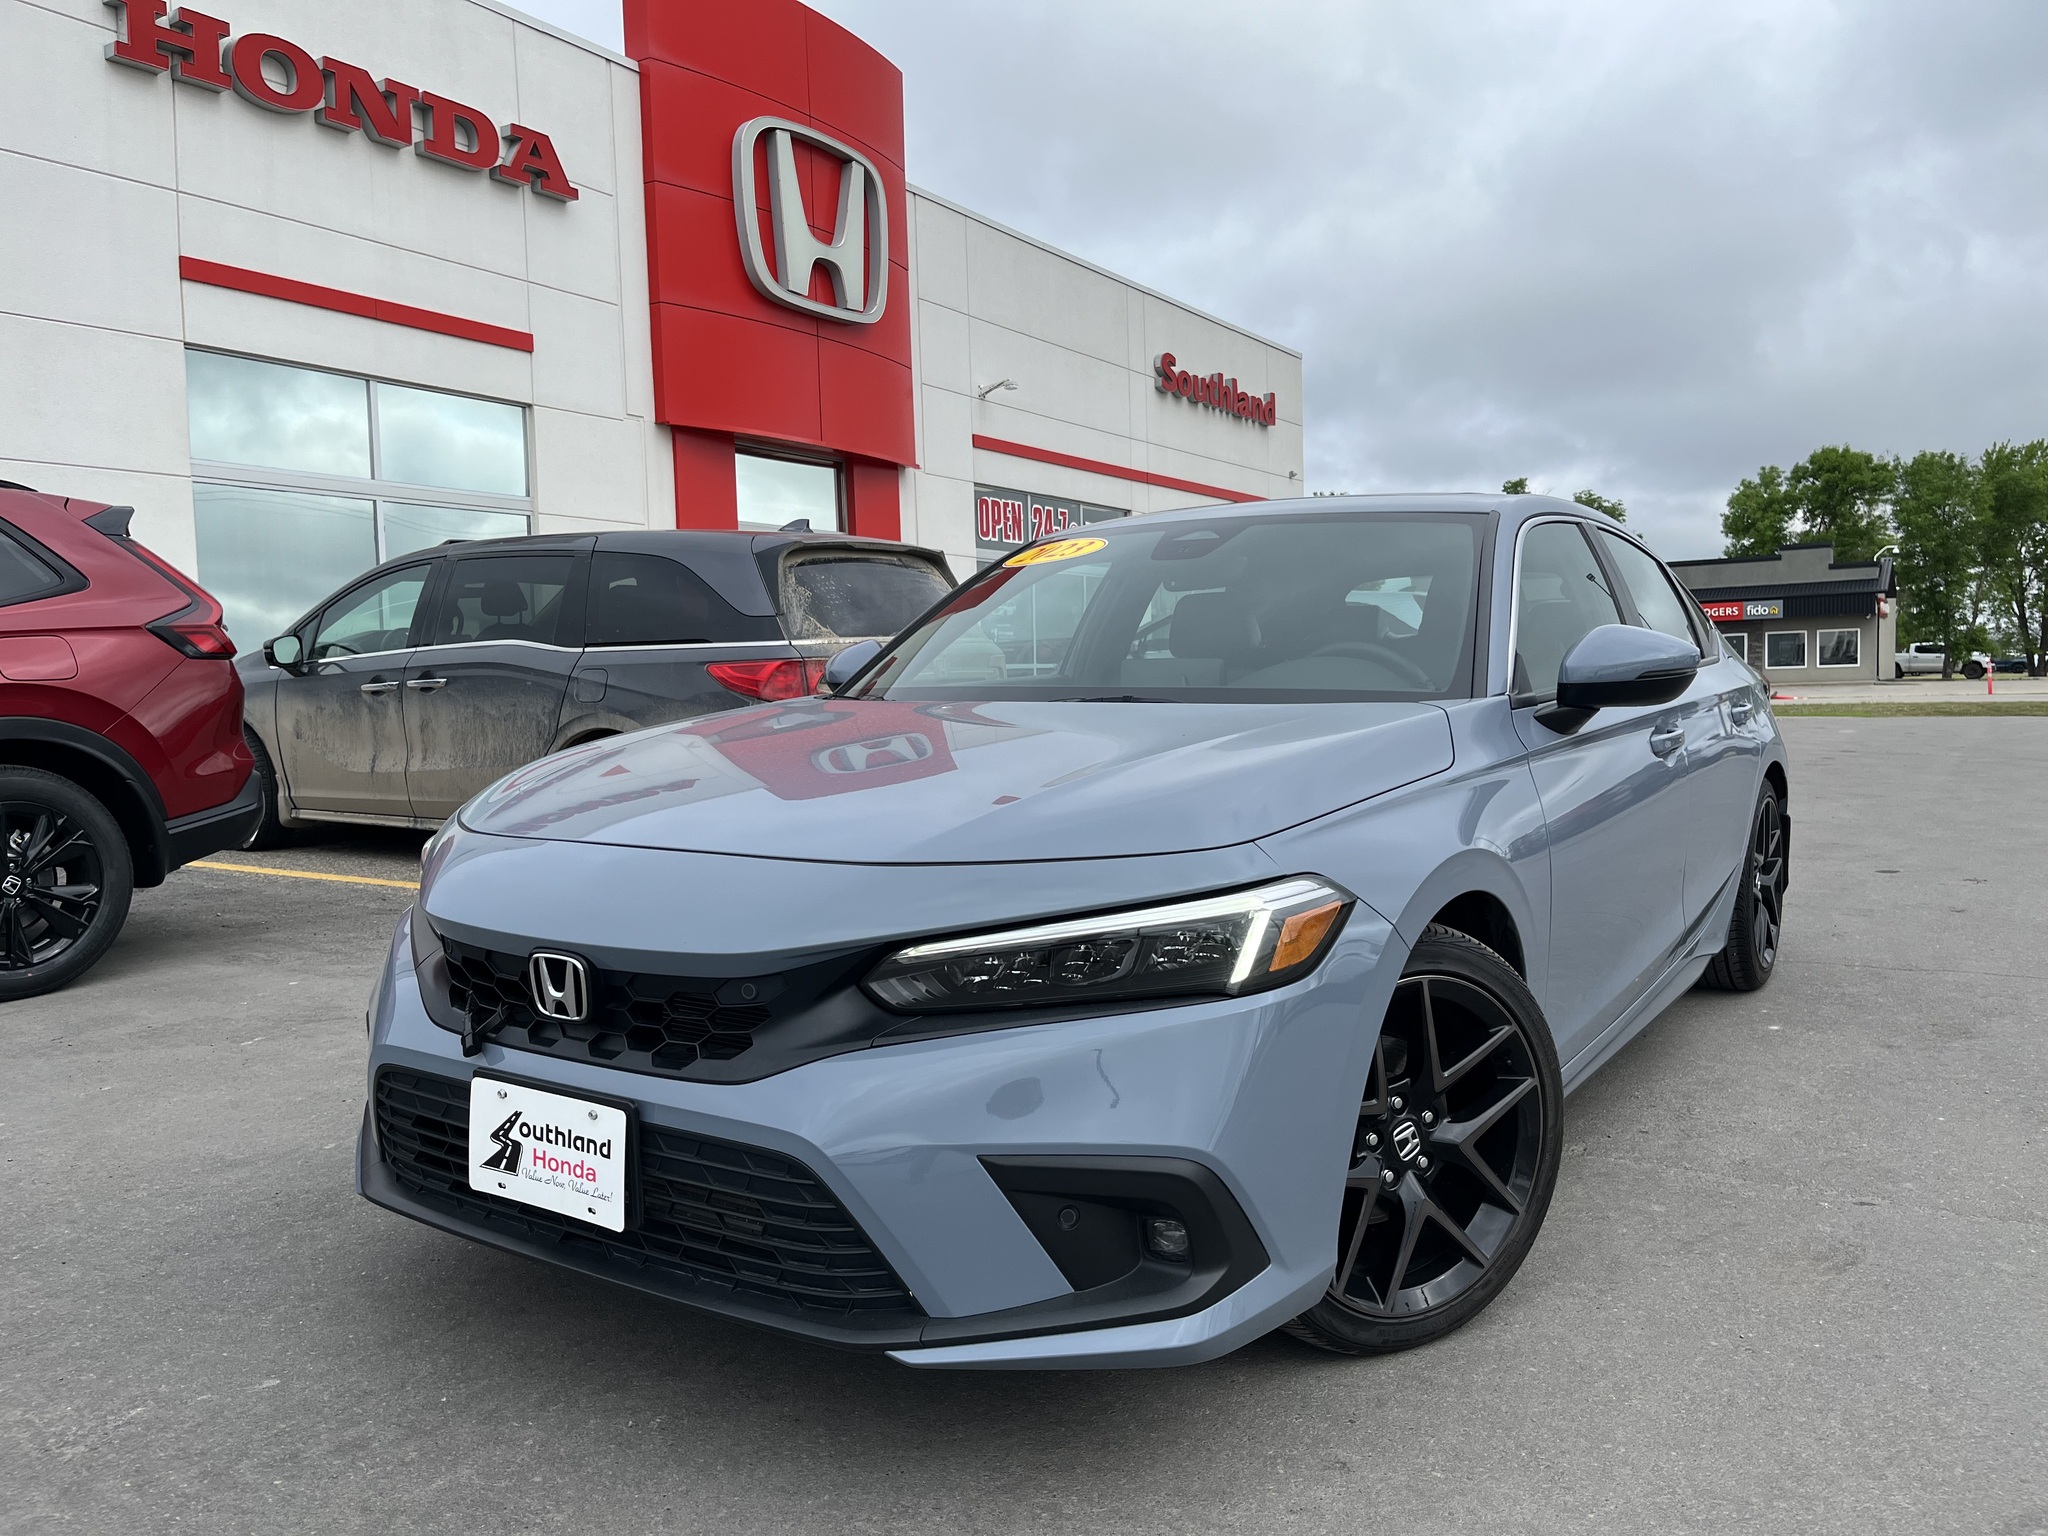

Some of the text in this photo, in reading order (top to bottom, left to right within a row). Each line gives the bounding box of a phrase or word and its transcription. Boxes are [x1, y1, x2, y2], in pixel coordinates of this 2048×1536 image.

[105, 0, 578, 201] HONDA
[1156, 352, 1276, 426] Southland
[978, 497, 1023, 544] OPEN
[1703, 606, 1739, 617] OGERS
[1746, 604, 1769, 616] fido
[532, 1147, 597, 1183] Honda
[521, 1167, 543, 1183] Value
[568, 1179, 590, 1196] Value
[591, 1187, 614, 1202] Later!
